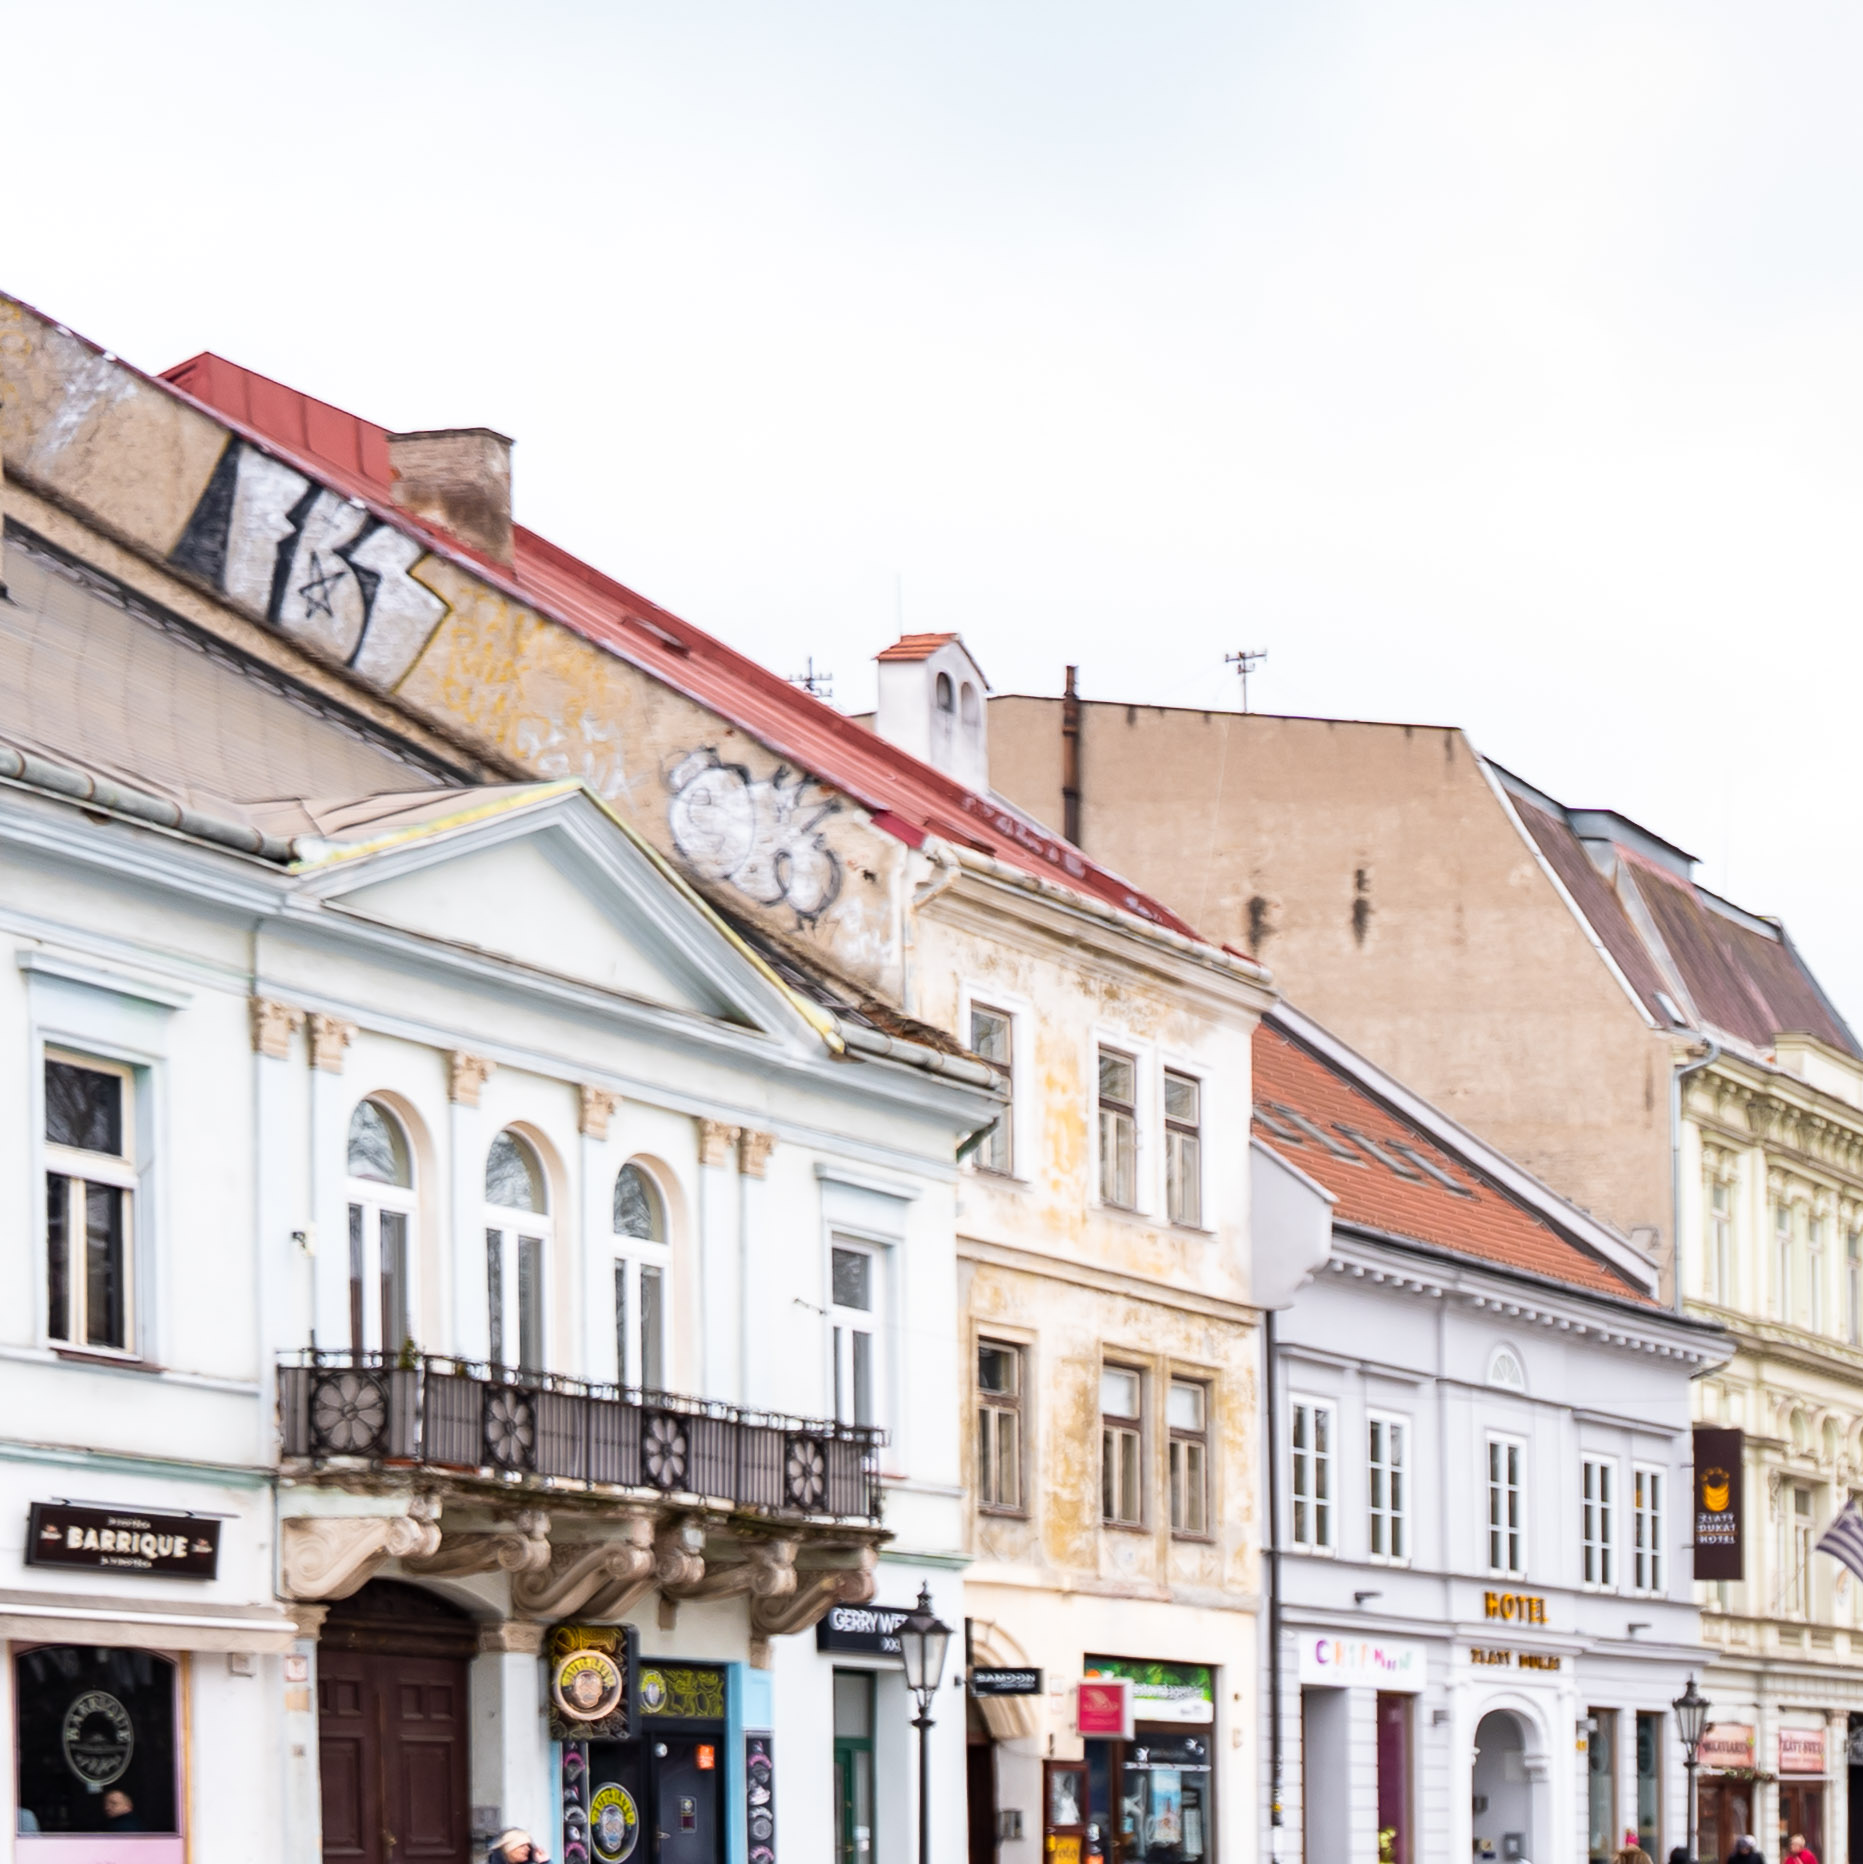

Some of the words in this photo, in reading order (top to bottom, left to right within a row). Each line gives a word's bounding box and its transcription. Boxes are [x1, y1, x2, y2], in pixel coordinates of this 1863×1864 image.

[66, 1525, 189, 1559] BARRIQUE
[1697, 1535, 1735, 1544] HOTEL
[829, 1607, 878, 1633] GERRY
[1484, 1592, 1549, 1624] HOTEL
